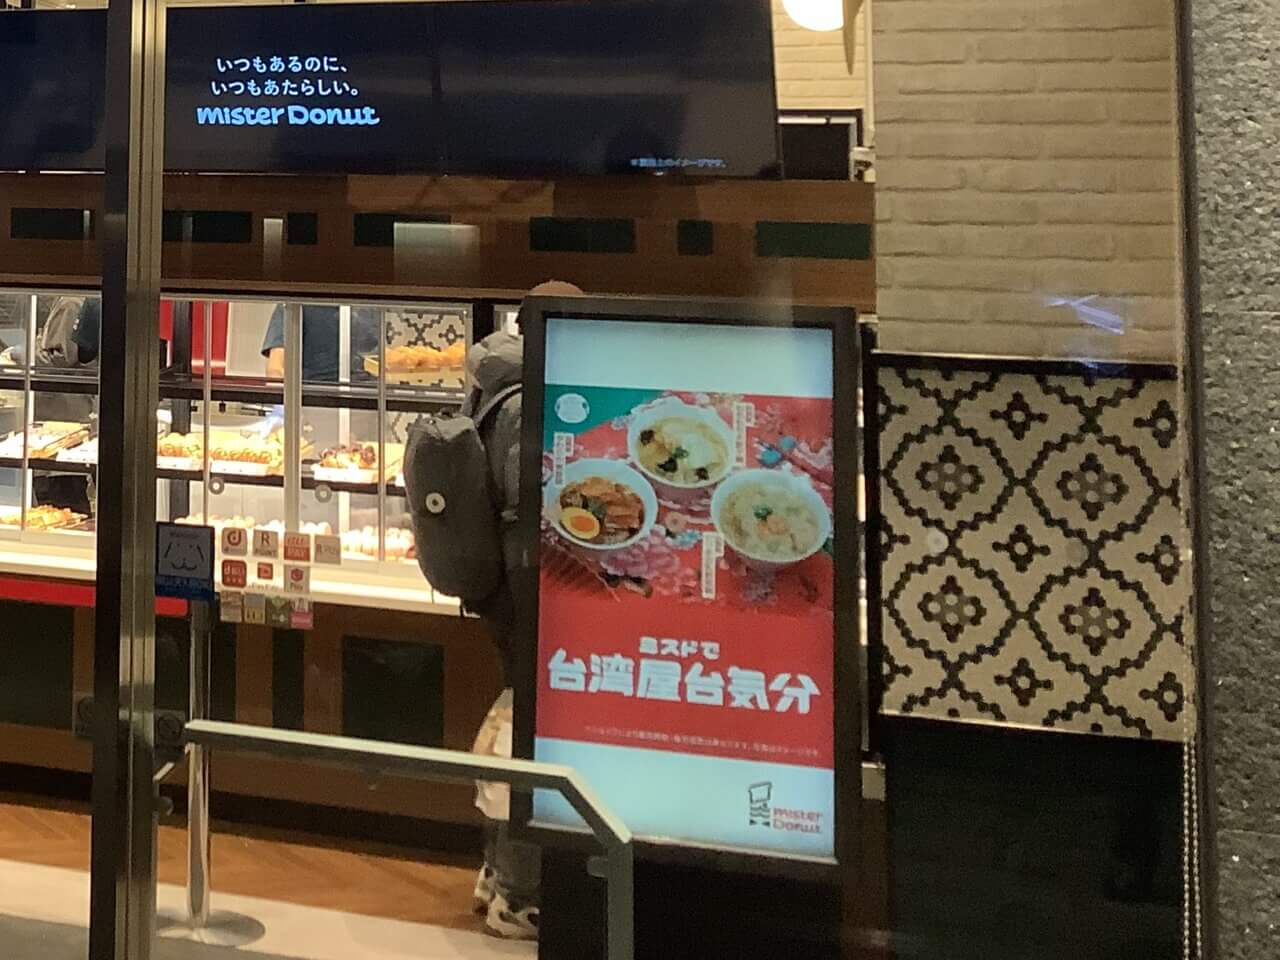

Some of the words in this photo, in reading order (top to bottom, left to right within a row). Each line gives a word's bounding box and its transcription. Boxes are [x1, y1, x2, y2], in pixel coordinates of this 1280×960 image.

[216, 55, 348, 73] いつもあるのに、
[211, 79, 359, 96] いつもあたらしい。
[287, 104, 380, 126] Donut
[639, 636, 720, 660] ミスドで
[548, 647, 821, 714] 台湾屋台気分
